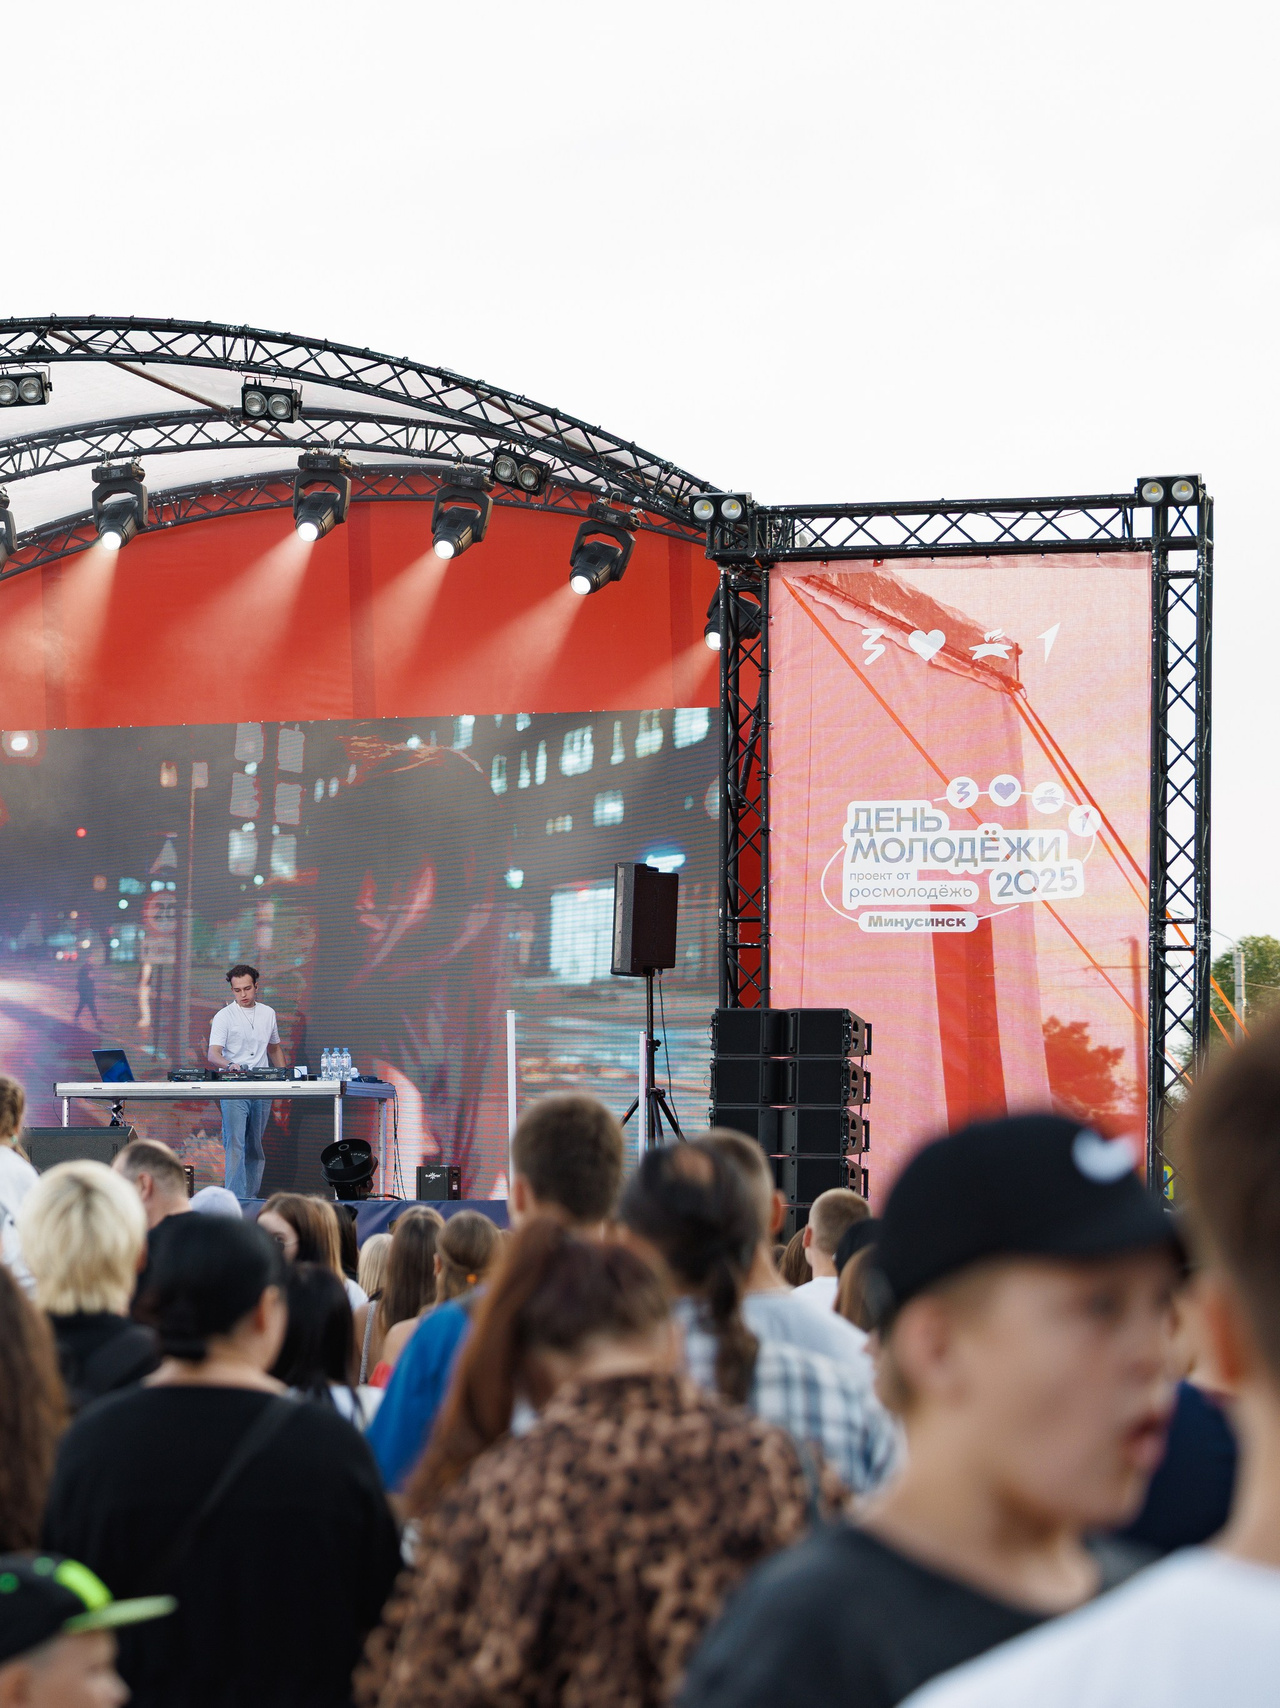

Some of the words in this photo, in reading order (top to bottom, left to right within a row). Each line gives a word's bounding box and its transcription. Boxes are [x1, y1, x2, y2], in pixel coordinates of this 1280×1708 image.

[850, 807, 943, 837] ДЕНЬ
[850, 829, 1061, 867] МОЛОДЁЖИ
[849, 872, 893, 882] проект
[896, 872, 911, 881] от
[995, 866, 1078, 897] 2025
[849, 884, 973, 903] росмолодёжь
[867, 915, 967, 931] Минусинск
